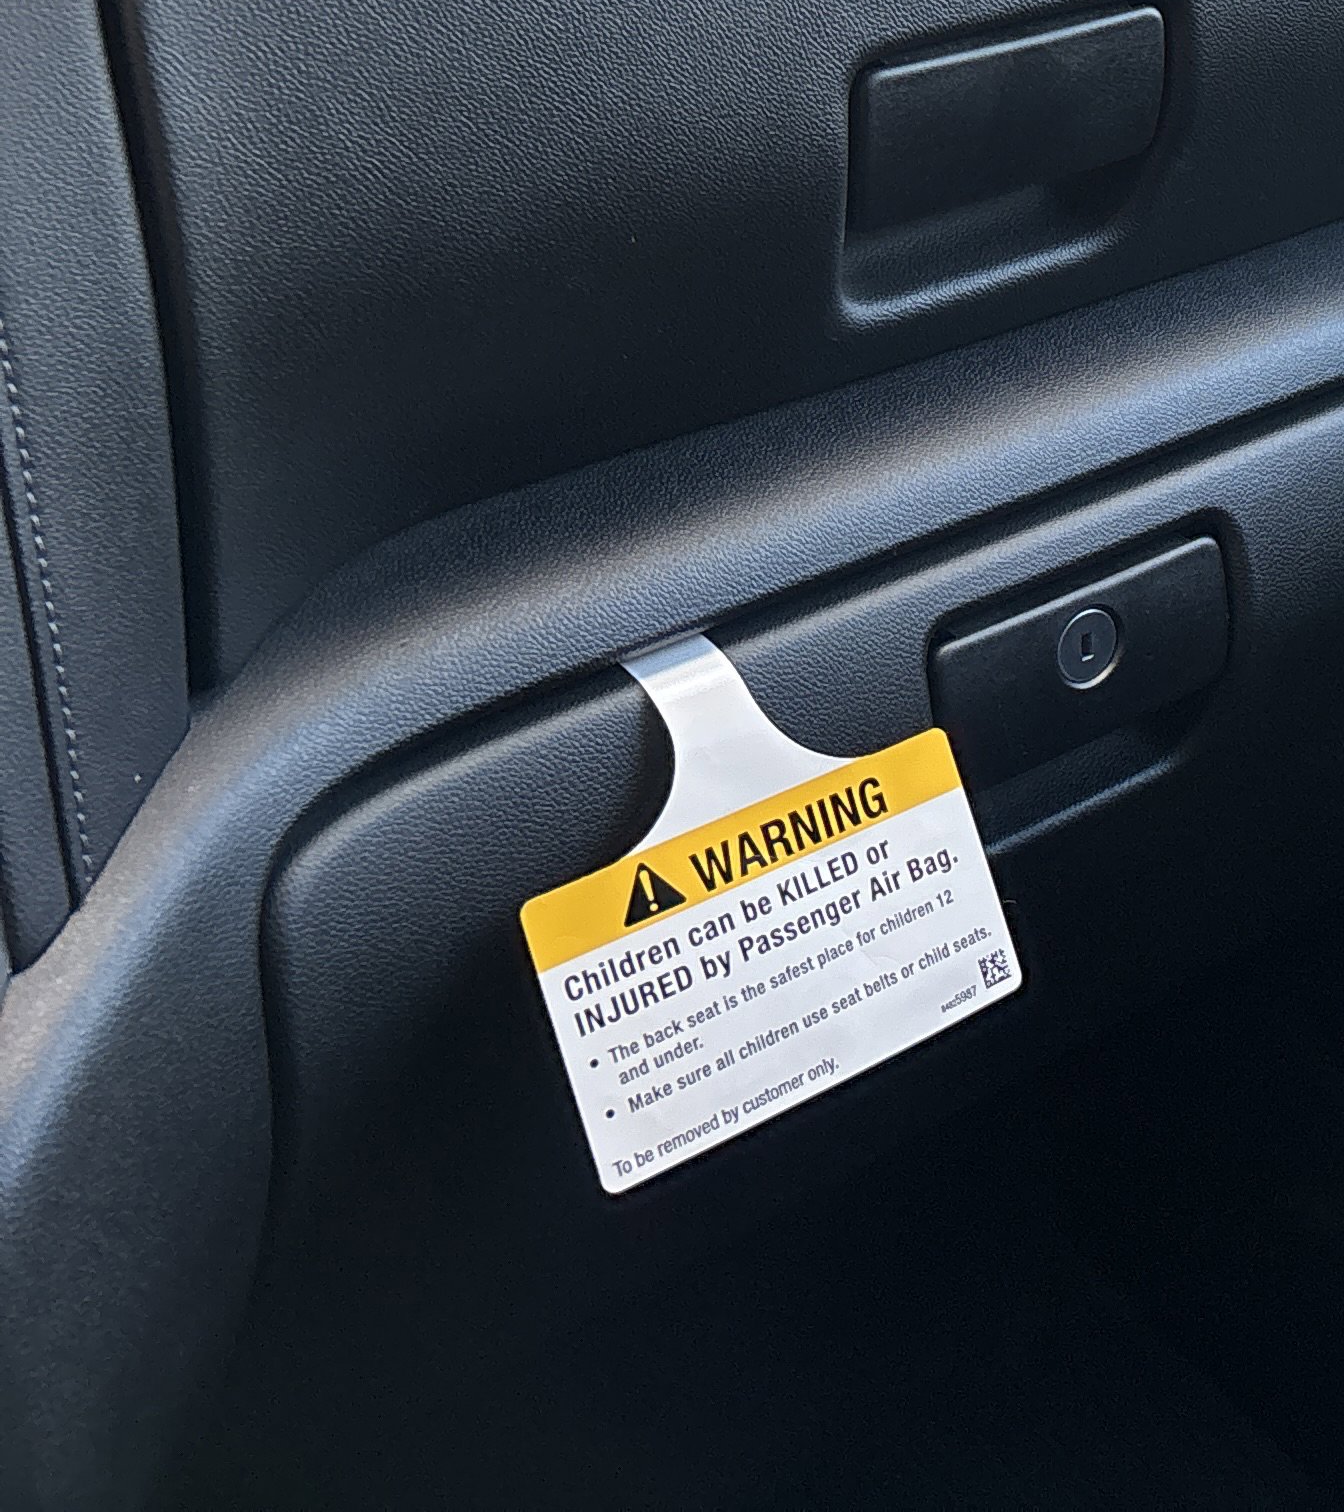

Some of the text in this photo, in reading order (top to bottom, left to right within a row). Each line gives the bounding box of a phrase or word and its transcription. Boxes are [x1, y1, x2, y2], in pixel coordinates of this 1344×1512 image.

[688, 777, 889, 893] WARNING
[564, 839, 889, 1001] Children can be KILLED or
[574, 848, 959, 1037] INJURED by Passenger Air Bag.
[608, 889, 954, 1064] The back seat is the safest place for children 12
[618, 1037, 704, 1085] and under.
[627, 926, 992, 1113] Make sure all children use seat belts or child seats.
[612, 1057, 840, 1177] To be removed by customer only.
